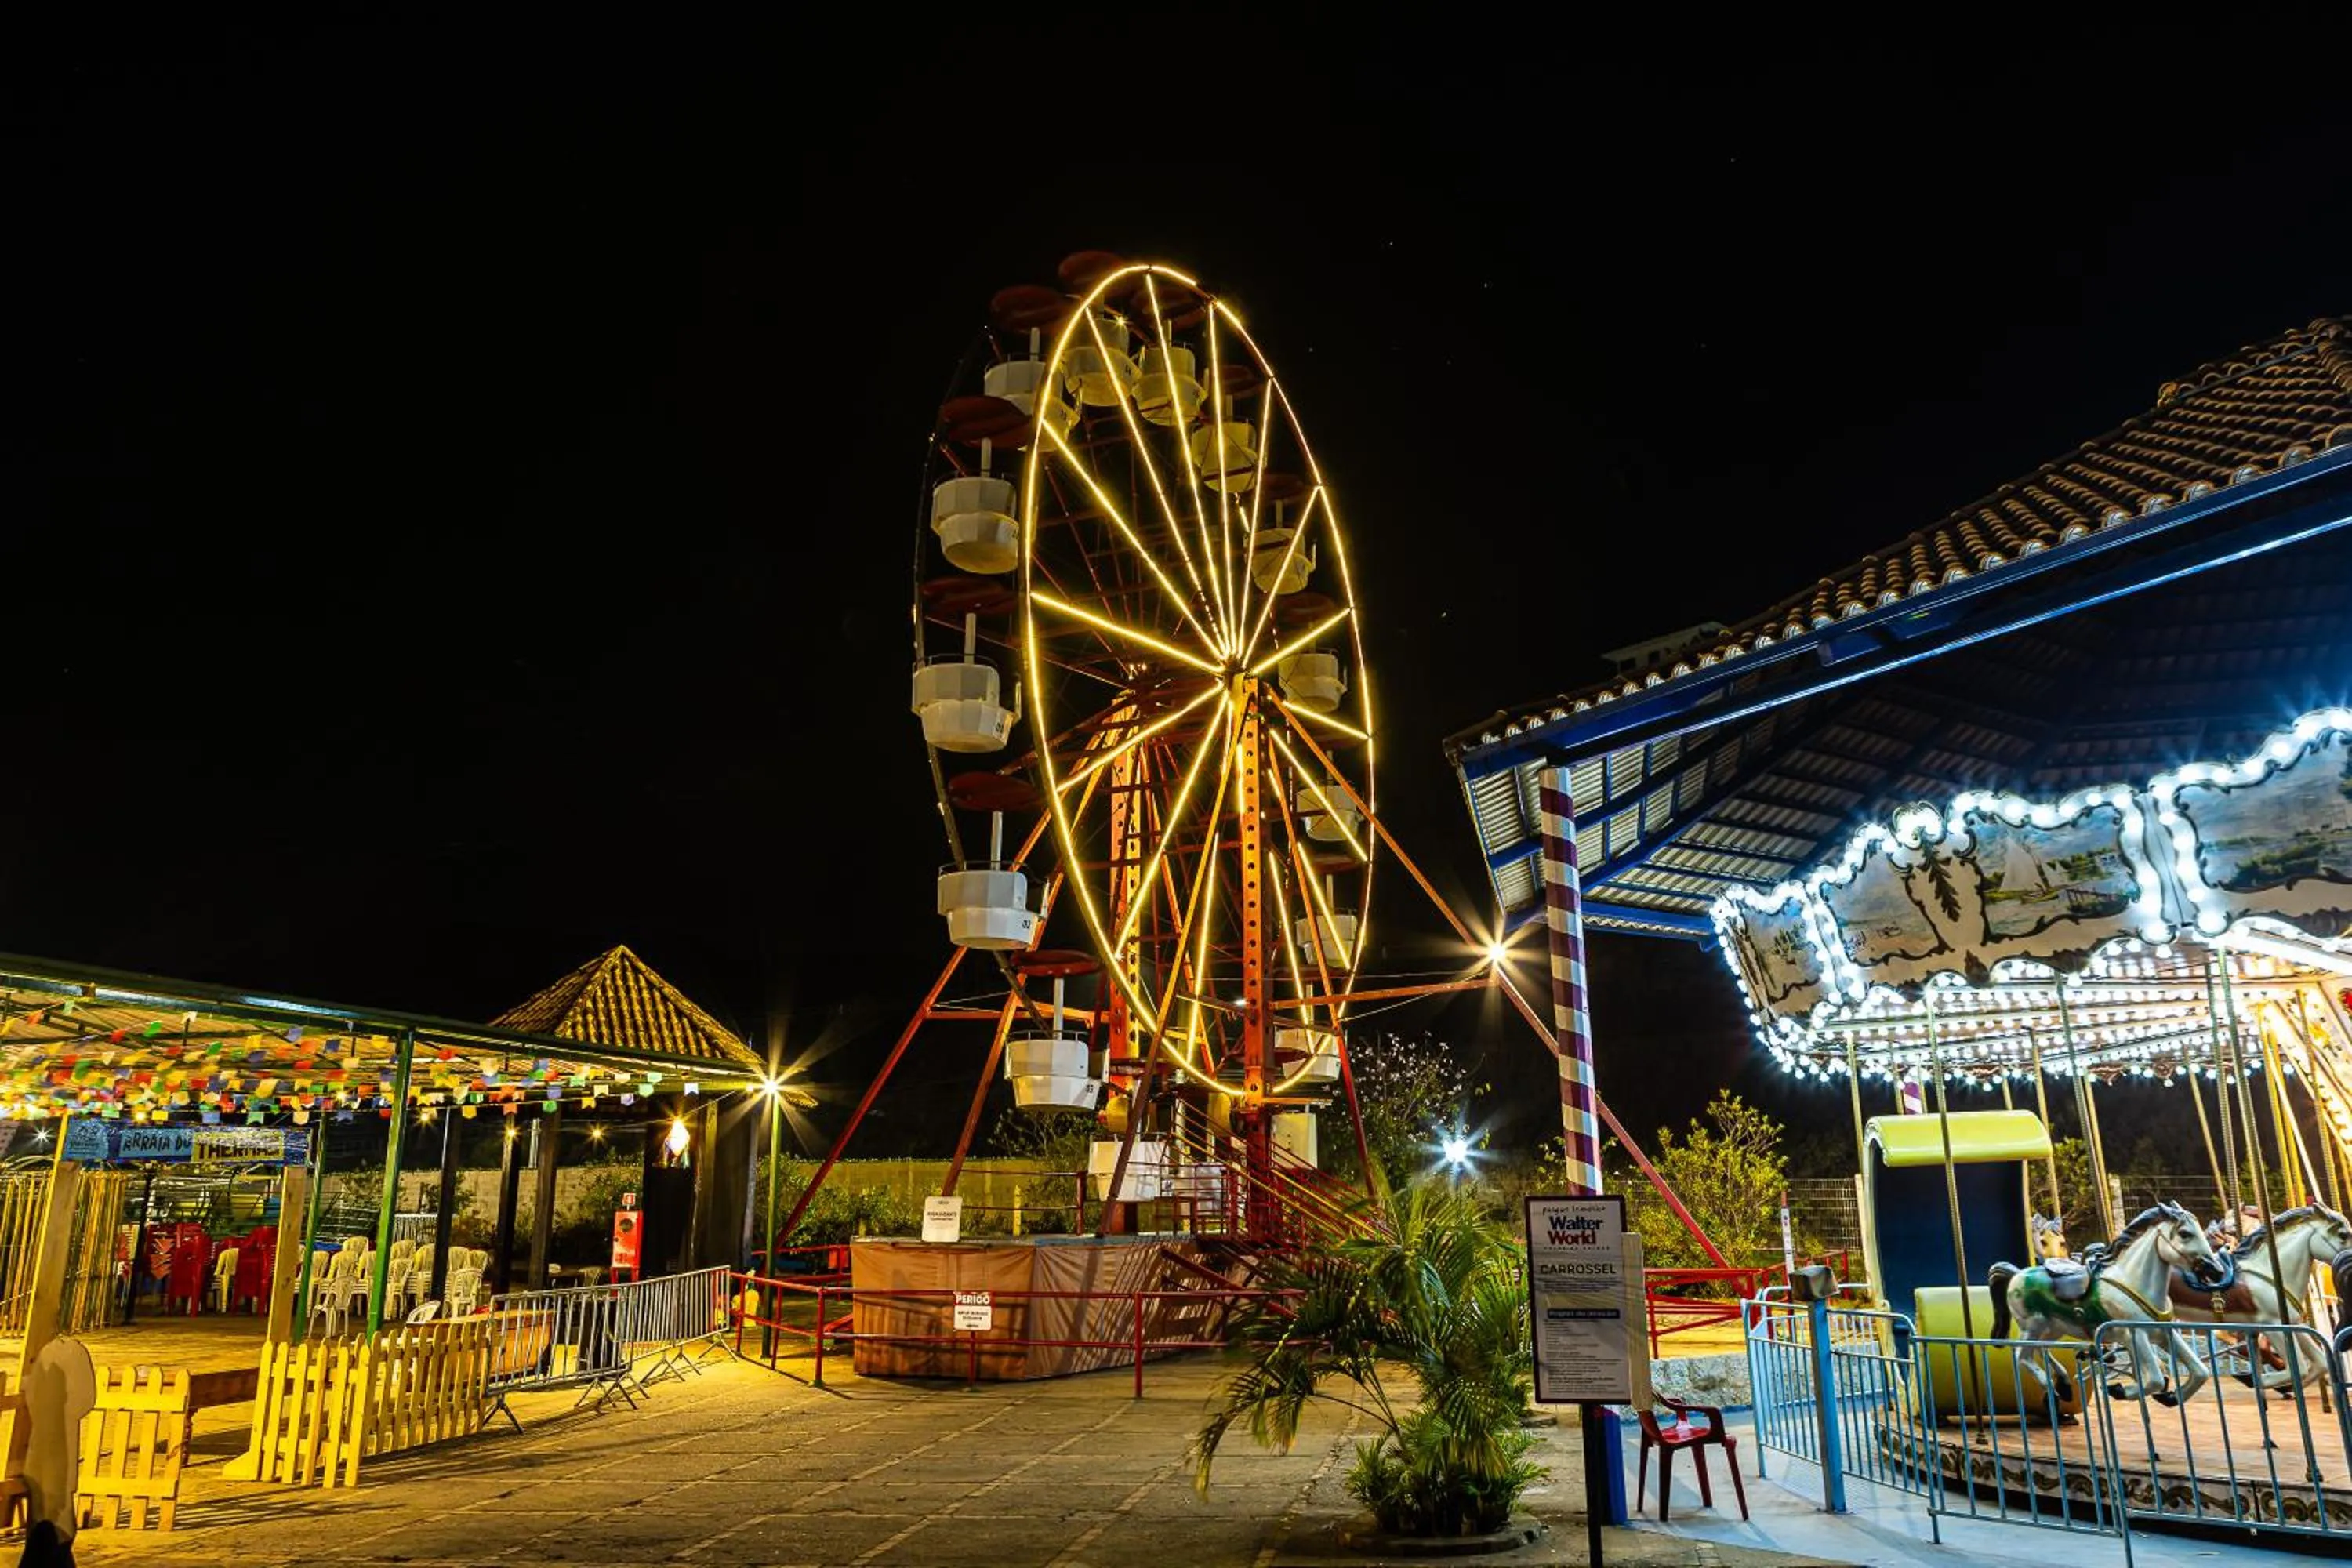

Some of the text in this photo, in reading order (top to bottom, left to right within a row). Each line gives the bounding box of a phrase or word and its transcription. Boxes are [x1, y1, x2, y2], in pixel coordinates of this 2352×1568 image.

[1549, 1216, 1603, 1230] Walter
[1548, 1230, 1596, 1245] World
[1540, 1264, 1617, 1275] CARROSSEL
[956, 1294, 990, 1304] PERIGO
